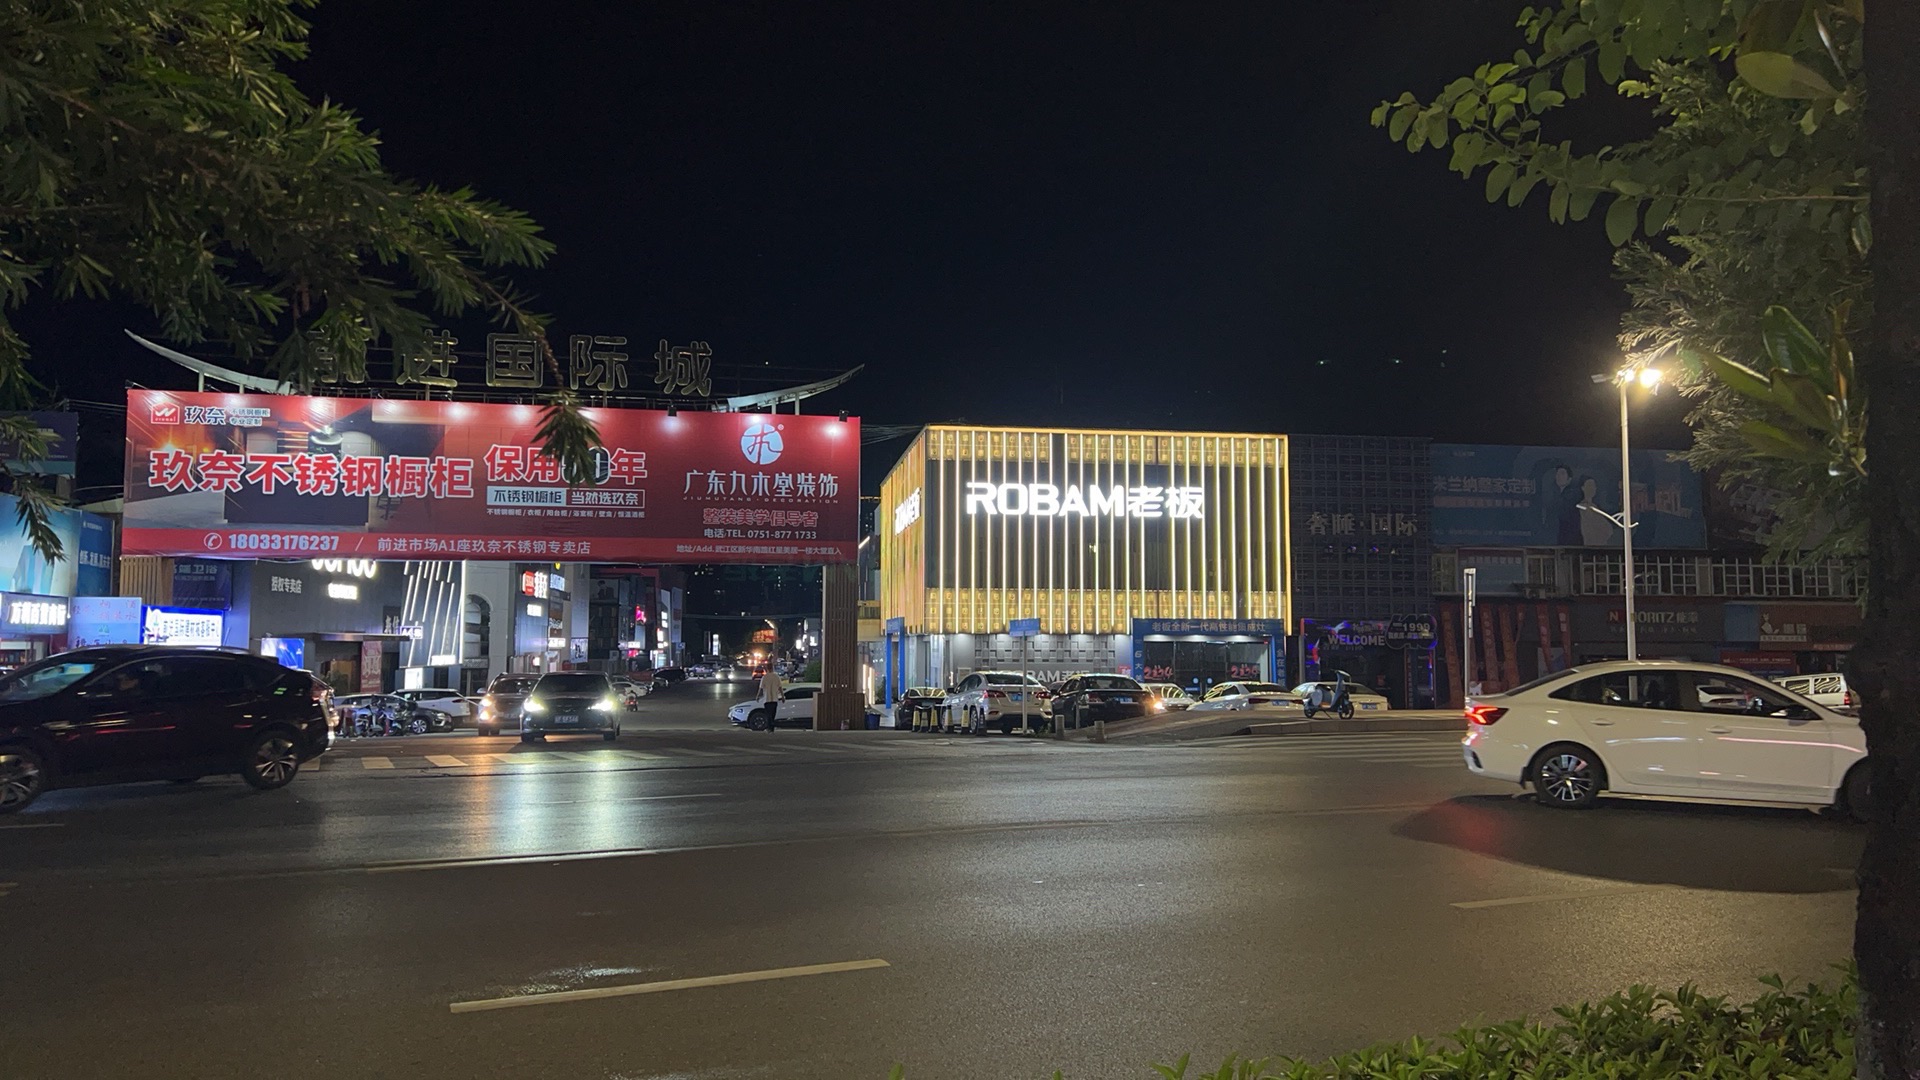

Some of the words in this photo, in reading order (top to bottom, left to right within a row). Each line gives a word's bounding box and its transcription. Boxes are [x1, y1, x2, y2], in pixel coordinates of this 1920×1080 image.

[184, 406, 226, 425] 玖奈
[483, 443, 648, 485] 保用0年
[148, 449, 474, 499] 玖奈不锈钢橱柜
[683, 469, 839, 498] 广东九木堂装饰
[493, 489, 563, 504] 不锈钢橱柜
[571, 491, 639, 505] 当然选玖奈
[703, 507, 819, 528] 整装美学倡导者
[228, 533, 339, 551] 18033176237
[747, 529, 792, 539] 0751-877
[795, 530, 817, 540] 1733
[377, 536, 591, 556] 前进市场A1座玖奈不锈钢专卖店
[1327, 634, 1386, 646] WELCOME
